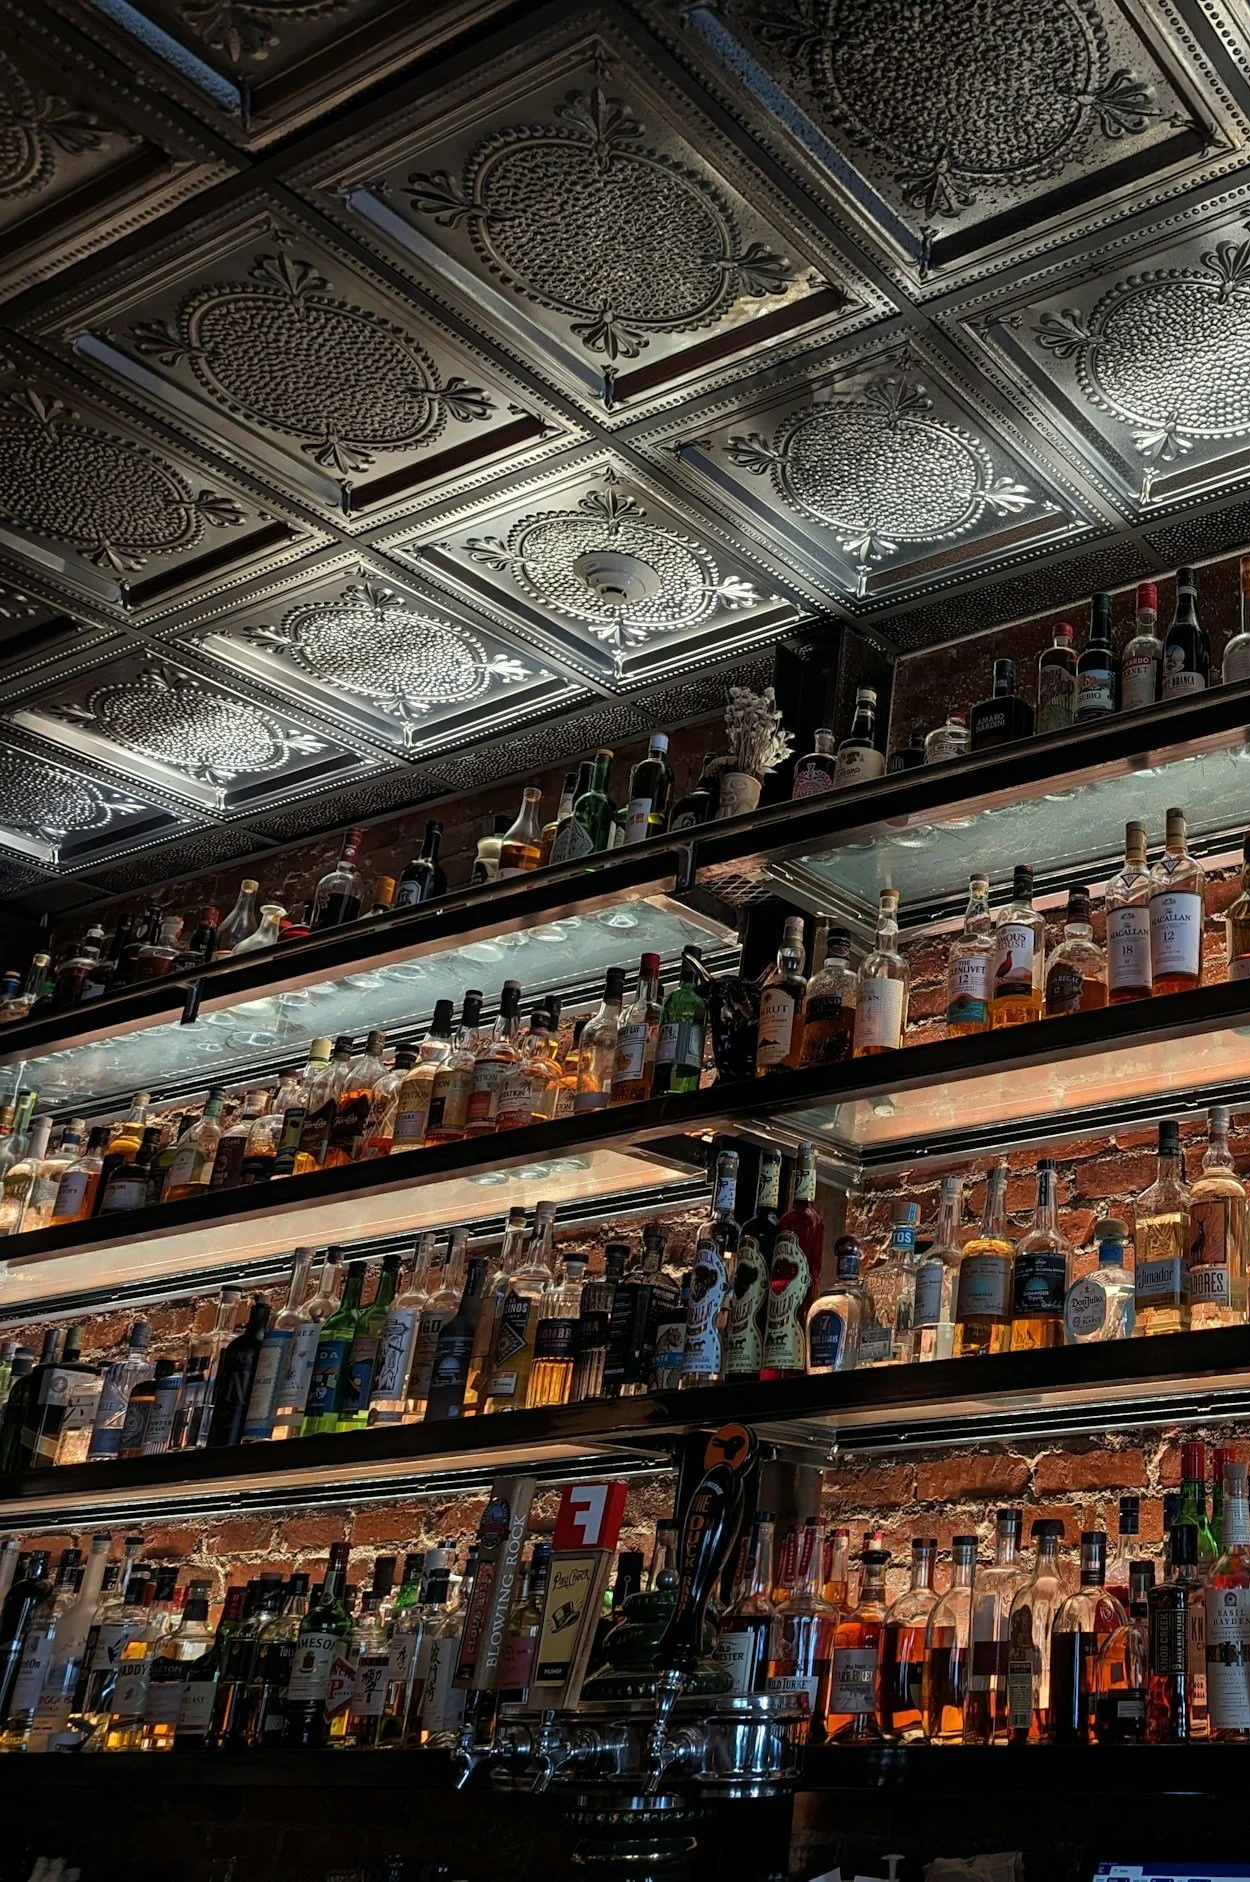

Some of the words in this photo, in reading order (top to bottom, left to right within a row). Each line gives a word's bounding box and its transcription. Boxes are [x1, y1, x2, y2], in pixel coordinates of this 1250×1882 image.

[978, 713, 1004, 726] AMARO
[976, 719, 1005, 734] NARDINI
[1152, 914, 1191, 924] MACALLAN
[1110, 929, 1149, 939] MACALLAN
[1162, 931, 1174, 942] 12
[1122, 943, 1132, 955] 18
[959, 975, 969, 984] 12
[822, 1315, 833, 1331] 7
[486, 1574, 515, 1668] BLOWING
[505, 1514, 527, 1567] ROCK
[1159, 1613, 1169, 1643] CREEK
[1159, 1644, 1169, 1671] KNOB
